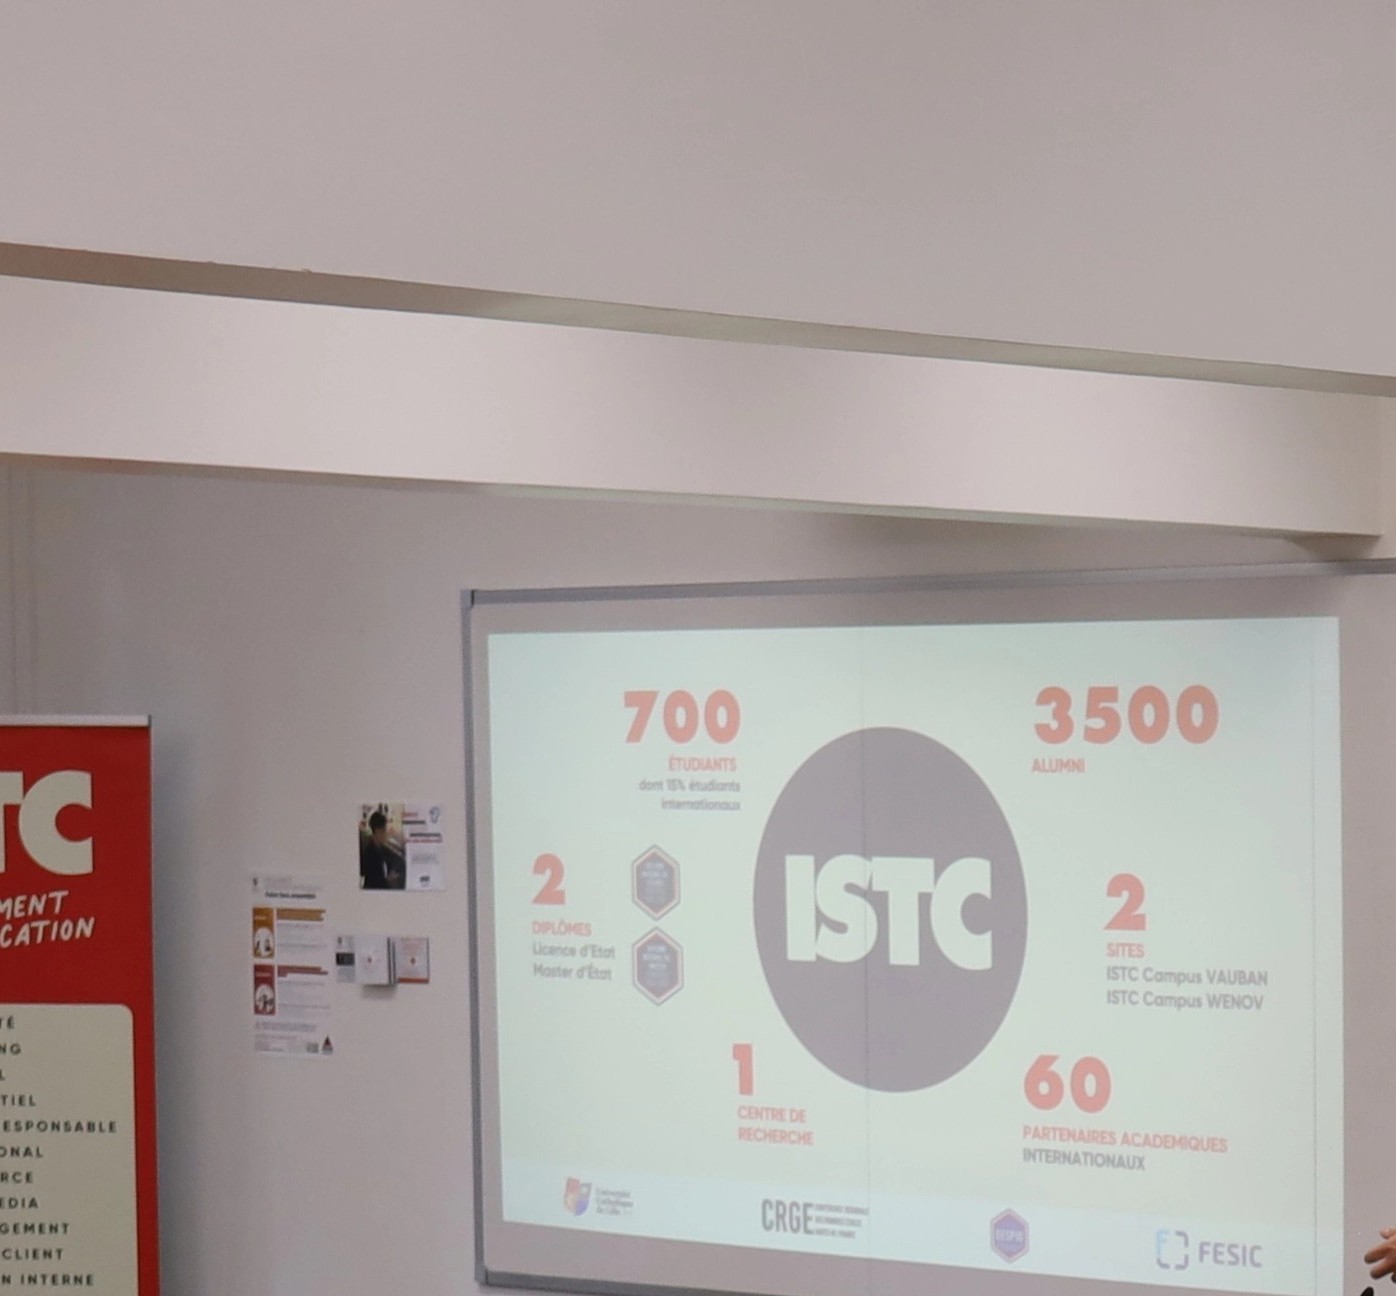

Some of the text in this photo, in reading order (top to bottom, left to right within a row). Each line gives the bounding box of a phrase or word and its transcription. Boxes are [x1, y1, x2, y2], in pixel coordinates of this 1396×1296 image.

[623, 689, 741, 744] 700
[1034, 684, 1219, 744] 3500
[668, 755, 737, 772] ÉTUDIANTS
[1032, 758, 1085, 774] ALUMNI
[639, 778, 741, 793] dont 15% étudiants
[661, 797, 741, 811] internationaux
[531, 853, 566, 905] 2
[1103, 873, 1147, 931] 2
[785, 854, 993, 971] ISTC
[532, 919, 592, 937] DIPLÔMES
[532, 943, 574, 959] Licence
[1106, 942, 1145, 959] SITES
[533, 964, 573, 980] Master
[1106, 966, 1268, 987] ISTC Campus VAUBAN
[1106, 990, 1264, 1012] ISTC Campus WENOV
[732, 1042, 753, 1096] 1
[1023, 1054, 1112, 1114] 60
[737, 1106, 806, 1124] CENTRE DE
[3, 1120, 117, 1133] ESPONSABLE
[738, 1126, 814, 1146] RECHERCHE
[1023, 1124, 1229, 1154] PARTENAIRES ACADEMIQUES
[1023, 1148, 1146, 1171] INTERNATIONAUX
[761, 1198, 815, 1236] CRGE
[2, 1248, 63, 1260] CLIENT
[1199, 1241, 1263, 1268] FESIC
[20, 1273, 94, 1286] INTERNE
